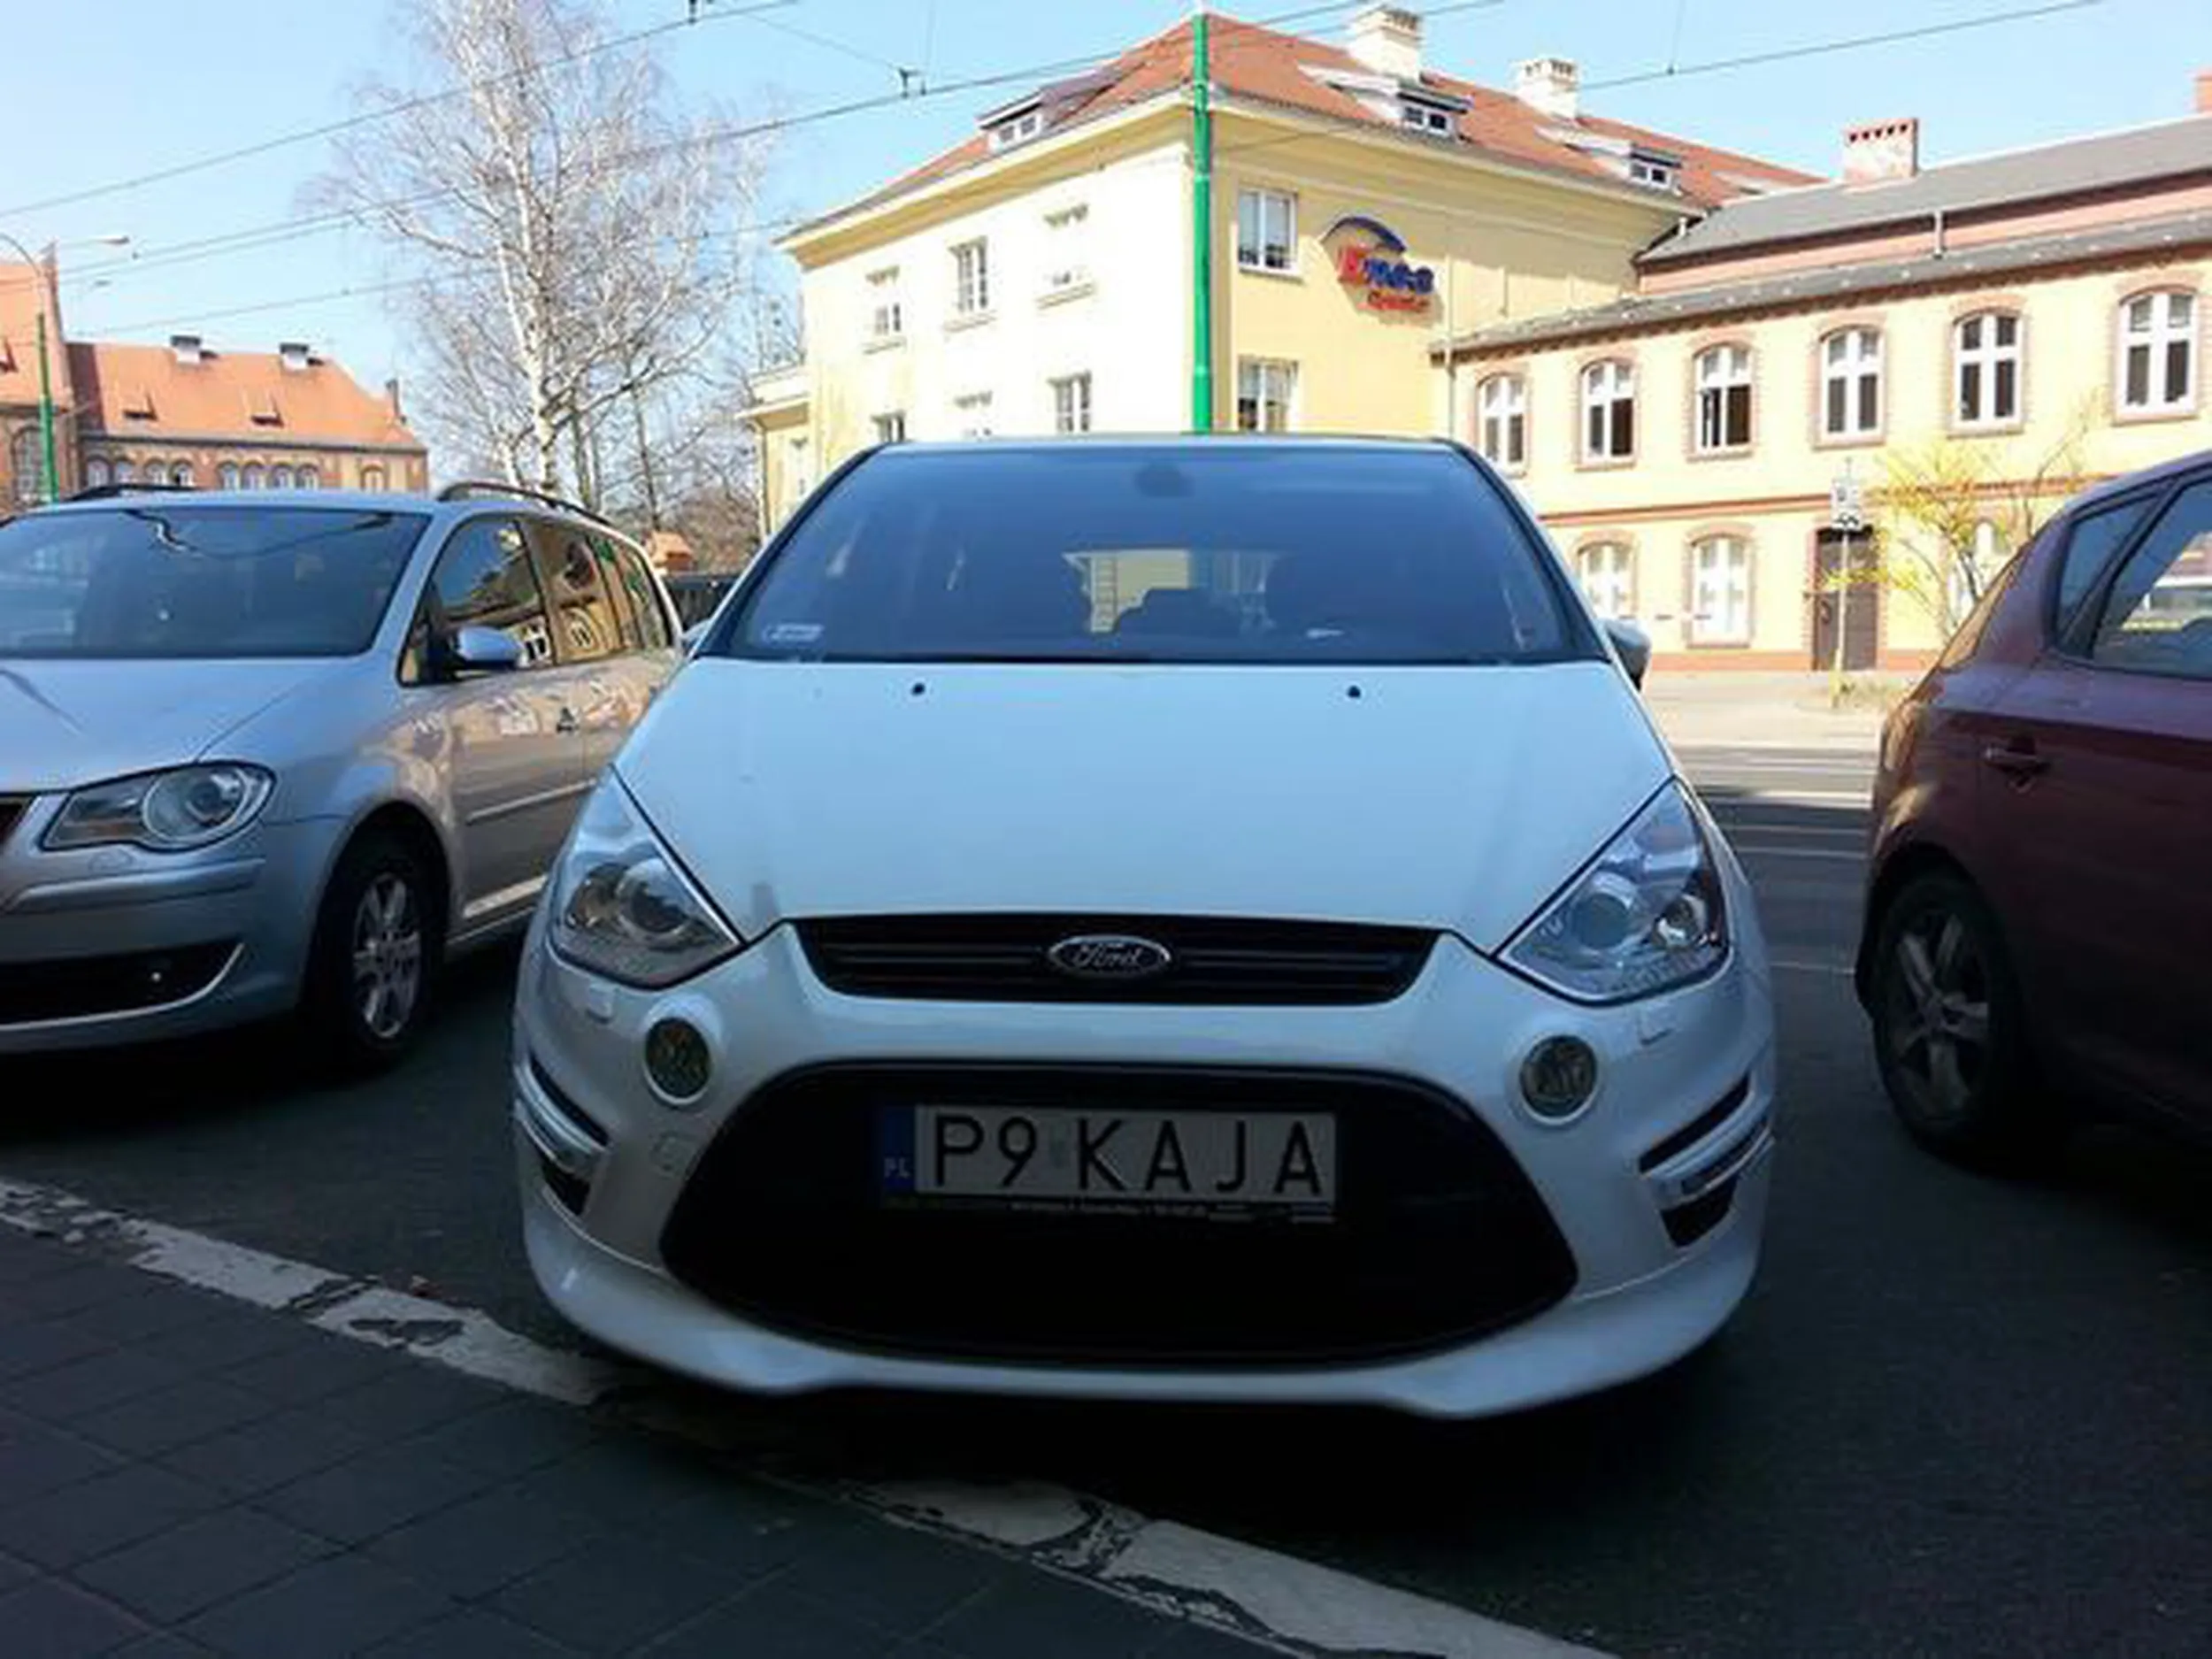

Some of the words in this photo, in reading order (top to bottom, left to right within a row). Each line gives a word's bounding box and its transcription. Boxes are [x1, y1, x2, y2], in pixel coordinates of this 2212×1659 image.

[1071, 942, 1144, 968] Ford
[884, 1156, 911, 1179] PL
[935, 1115, 1038, 1188] P9
[1078, 1117, 1322, 1194] KAJA
